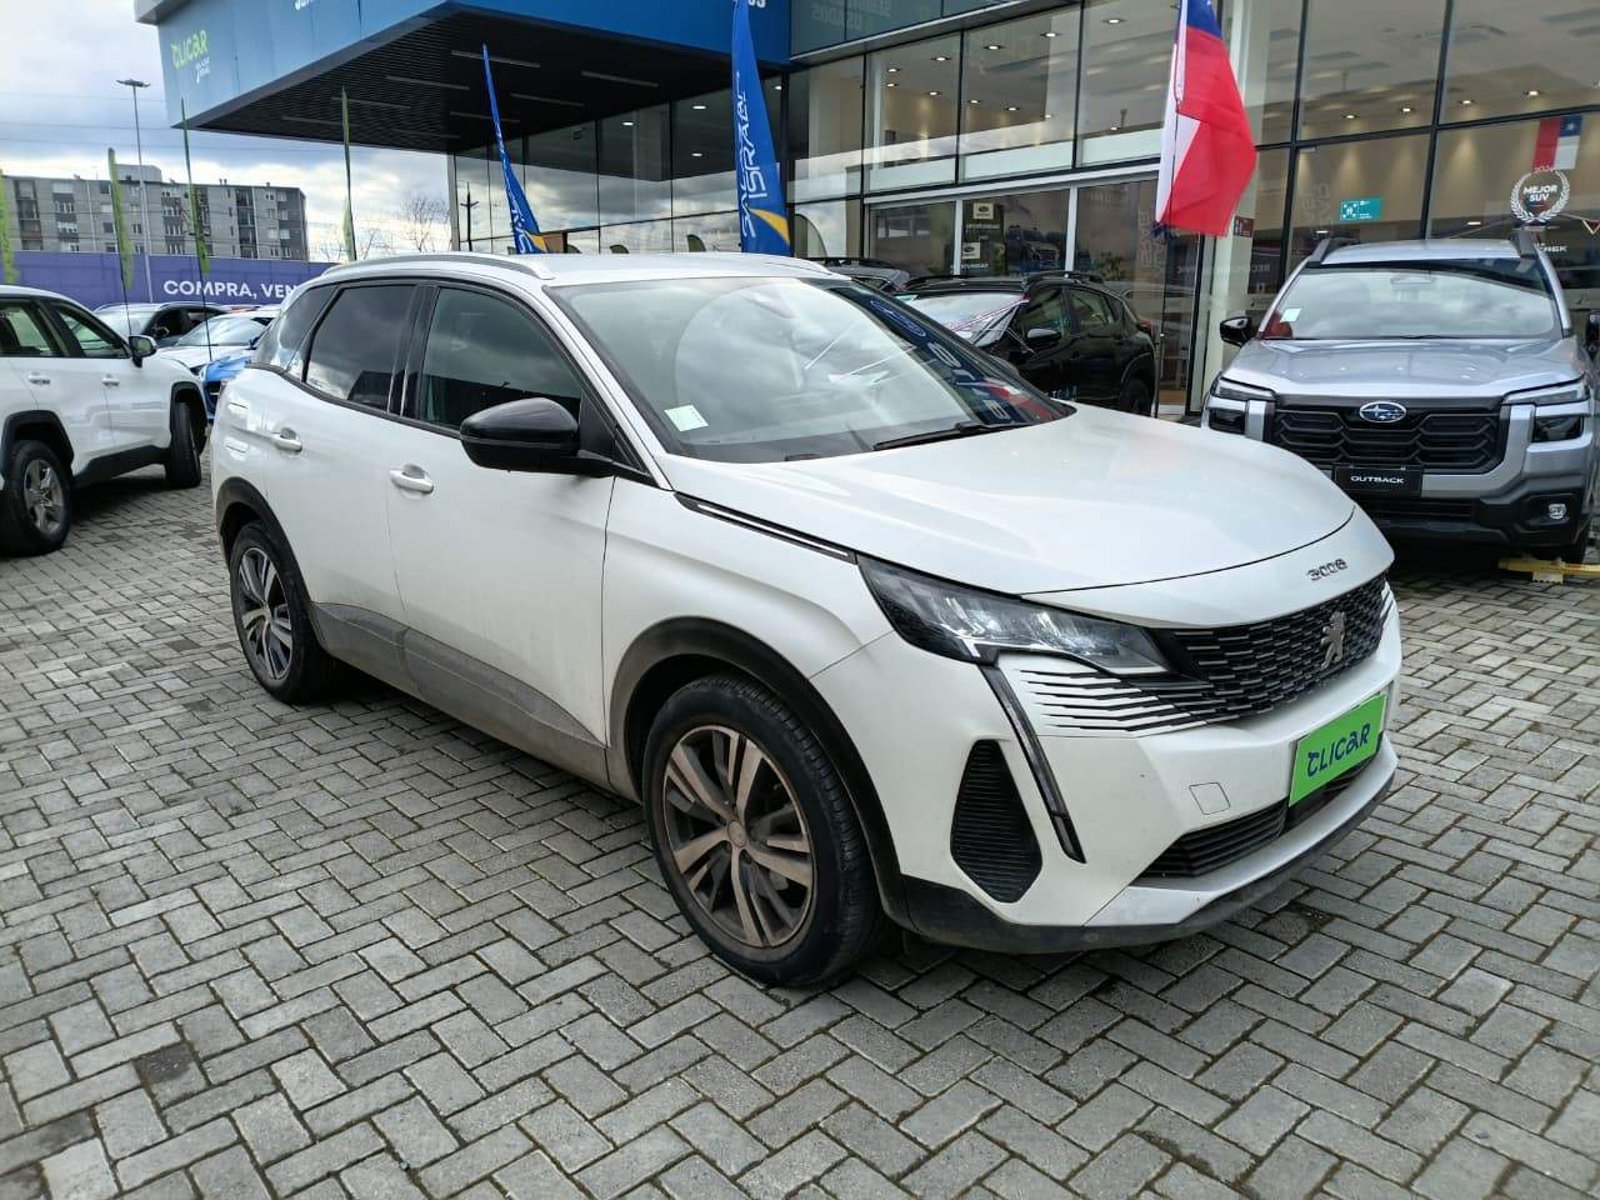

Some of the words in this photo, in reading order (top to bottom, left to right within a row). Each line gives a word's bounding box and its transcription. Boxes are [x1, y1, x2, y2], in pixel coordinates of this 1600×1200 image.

[1523, 184, 1558, 195] MEJOR
[1529, 193, 1549, 202] SUV
[164, 280, 257, 300] COMPRA,
[1350, 475, 1405, 484] OUTBACK
[1307, 558, 1348, 581] 3008
